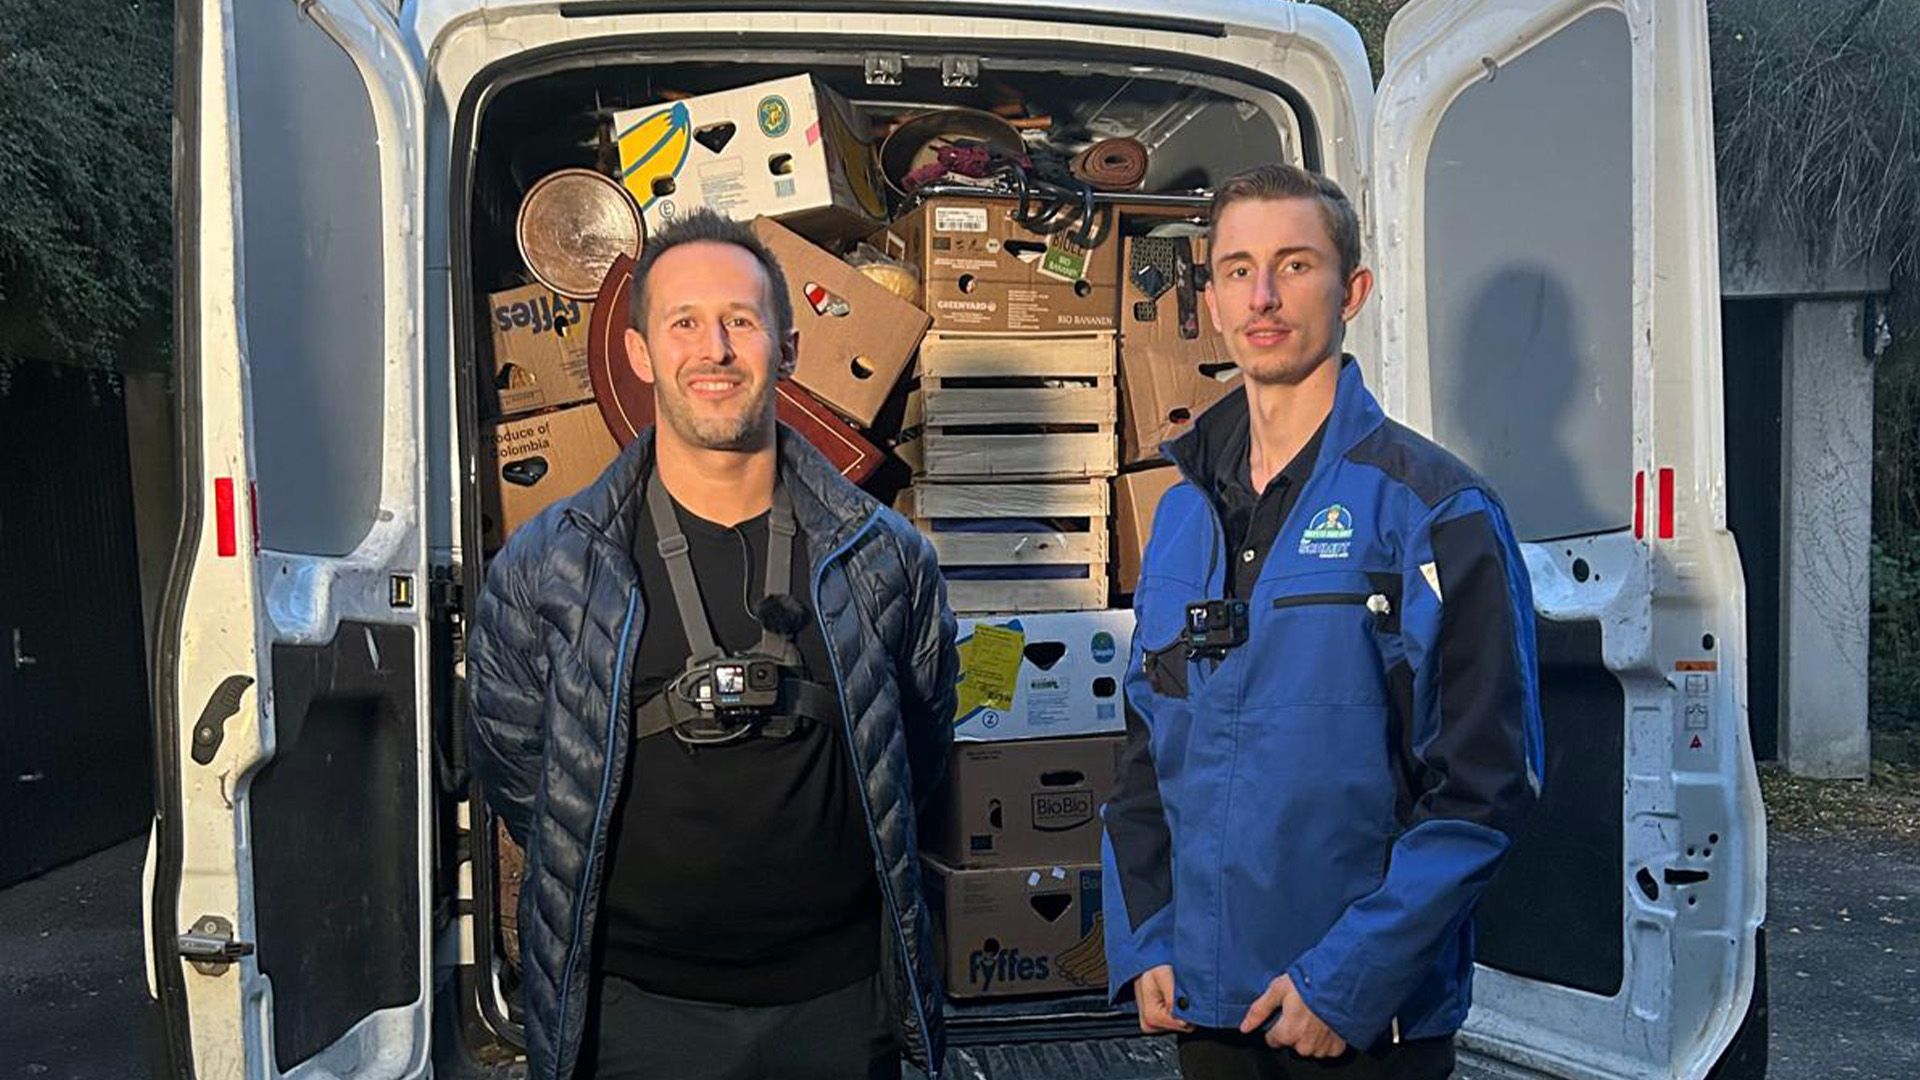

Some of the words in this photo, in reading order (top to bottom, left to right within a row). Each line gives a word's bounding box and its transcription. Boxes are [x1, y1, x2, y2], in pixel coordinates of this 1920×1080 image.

[937, 300, 986, 312] GREENYARD
[1058, 315, 1073, 325] BIO
[1074, 315, 1113, 326] BANANEN
[496, 439, 550, 458] olombia
[1037, 797, 1088, 815] BioBio
